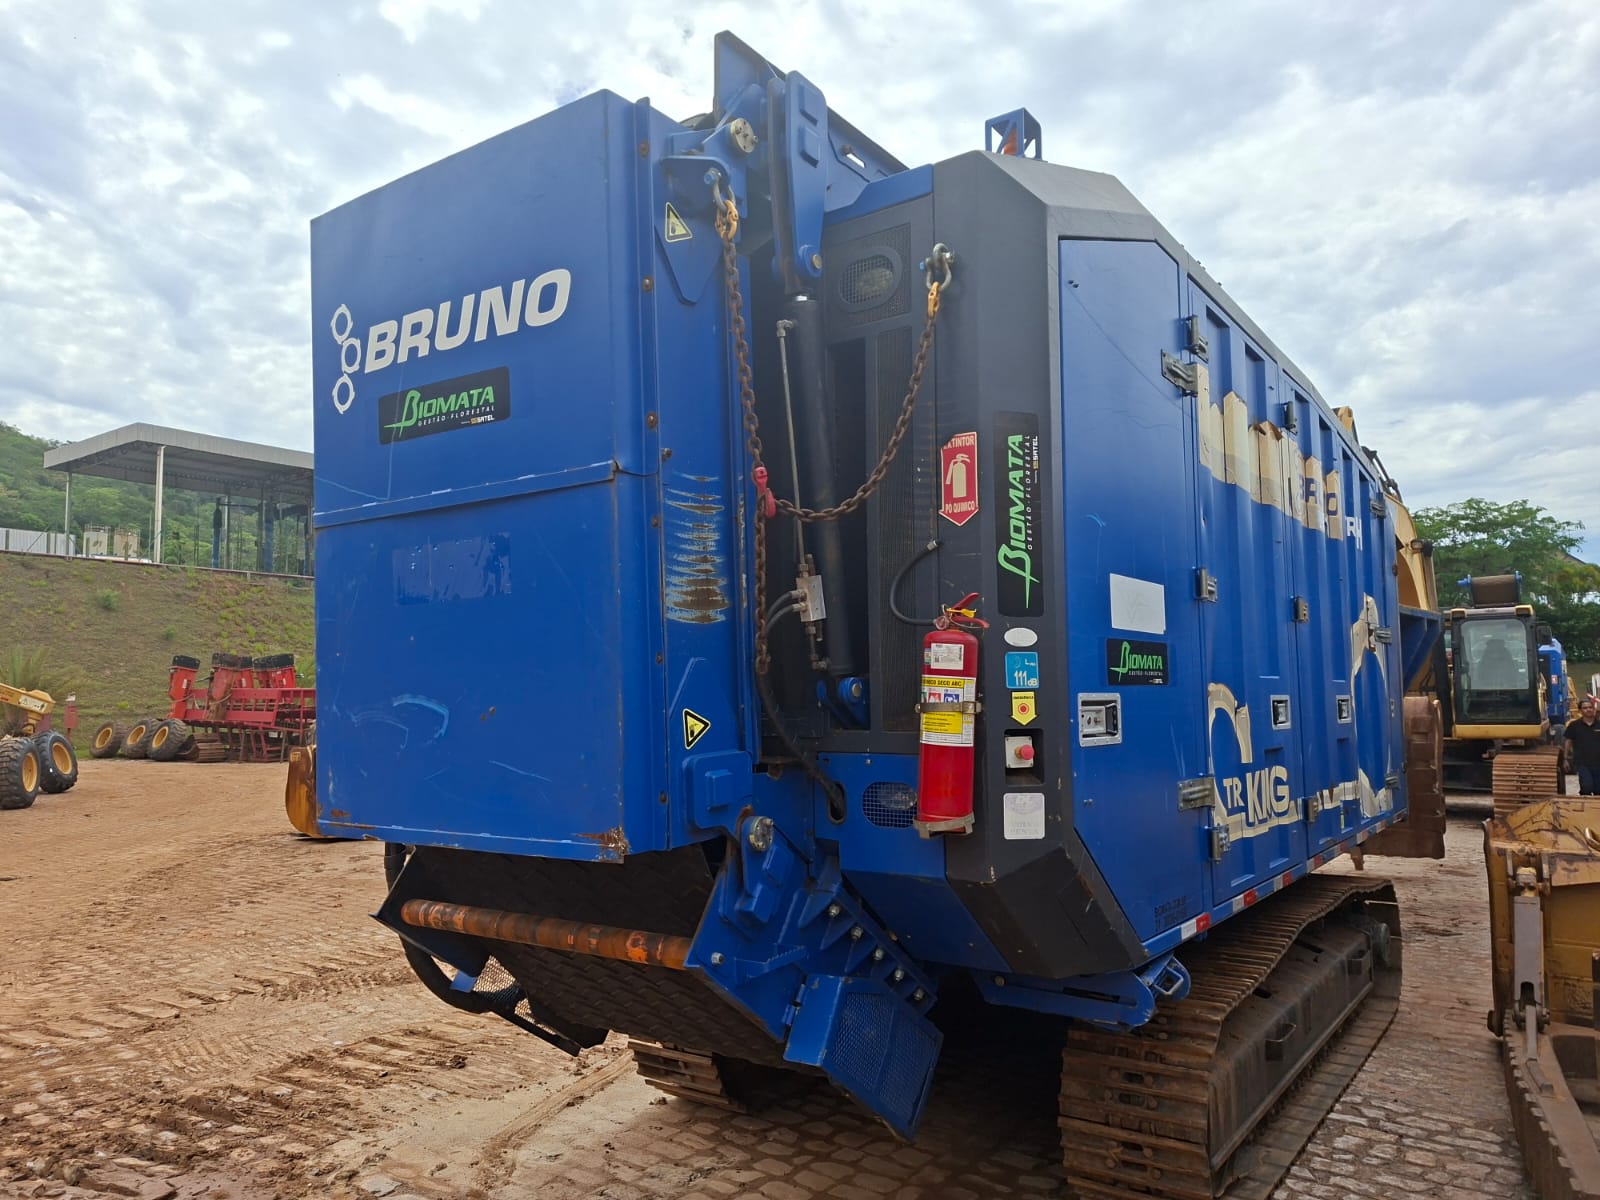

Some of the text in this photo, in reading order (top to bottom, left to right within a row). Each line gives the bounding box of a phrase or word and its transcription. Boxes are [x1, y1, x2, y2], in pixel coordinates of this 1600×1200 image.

[364, 268, 572, 375] BRUNO
[384, 385, 495, 439] BIOMATA
[450, 405, 495, 419] FLORESTAL
[1024, 435, 1032, 500] FLORESTAL
[997, 434, 1040, 609] BIOMATA
[1109, 640, 1163, 682] BIOMATA
